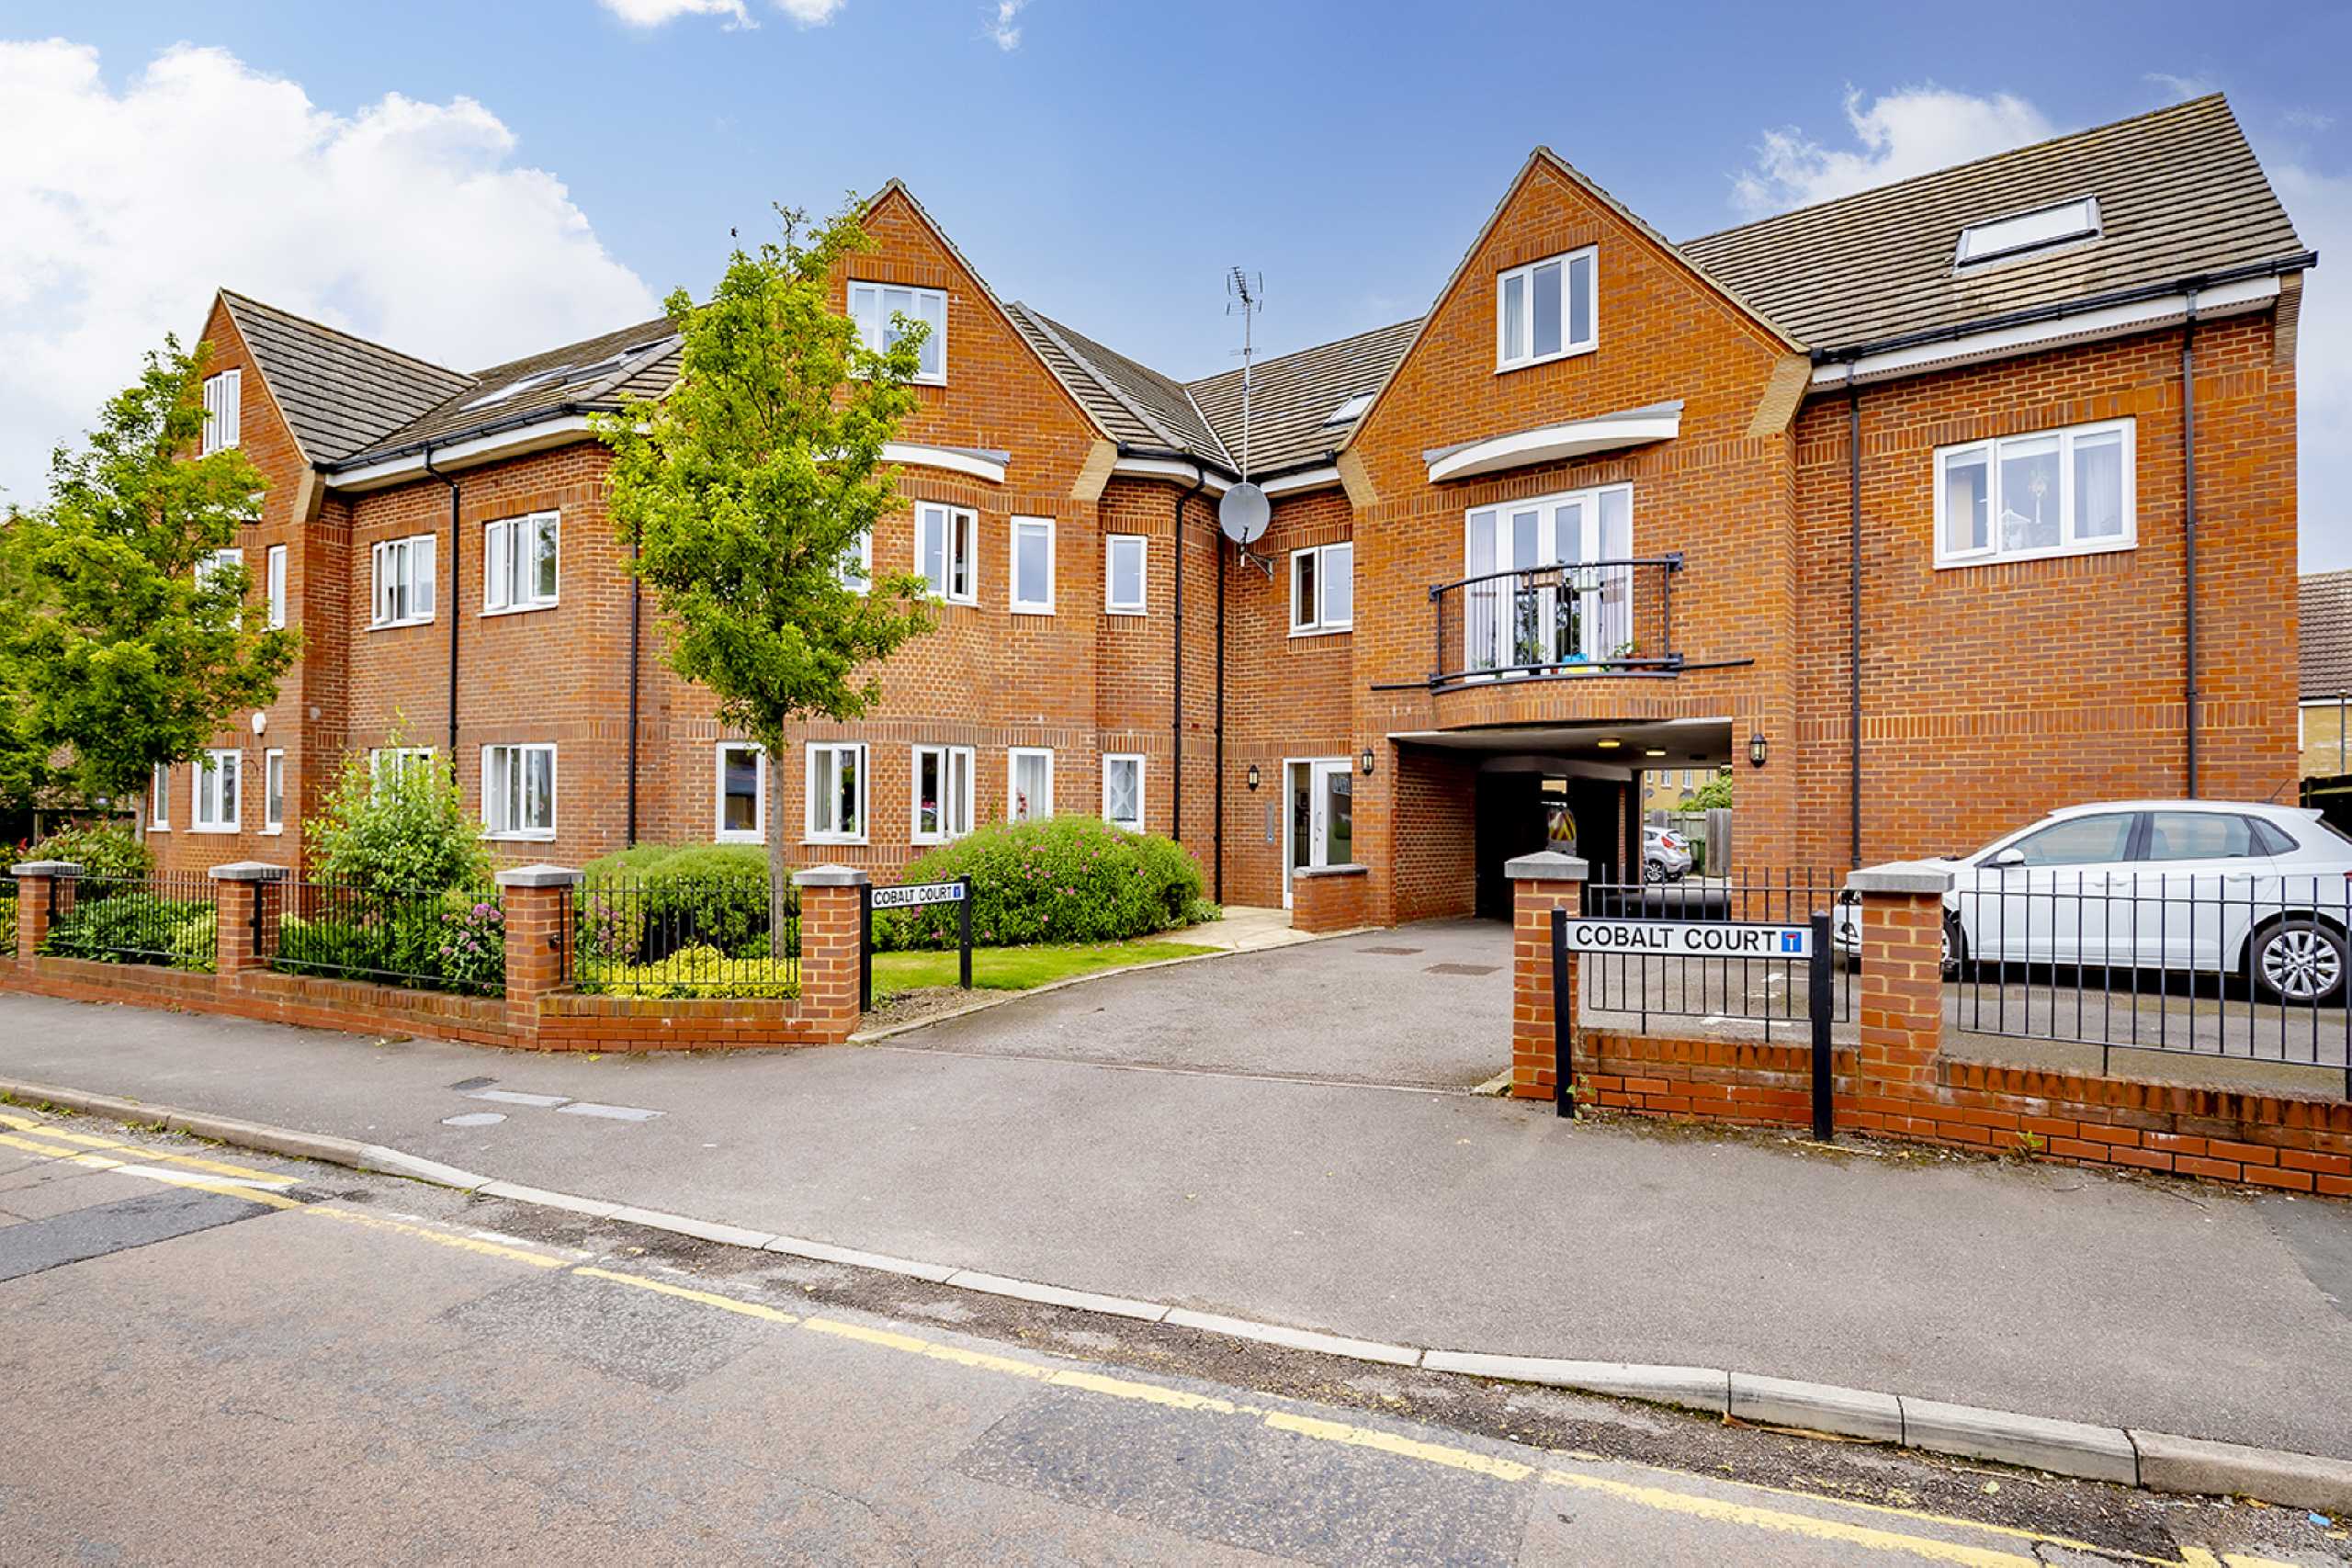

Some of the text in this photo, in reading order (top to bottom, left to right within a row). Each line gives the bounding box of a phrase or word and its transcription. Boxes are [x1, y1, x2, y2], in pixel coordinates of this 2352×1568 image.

[874, 886, 951, 905] COBALT COURT
[1576, 926, 1776, 951] COBALT COURT
